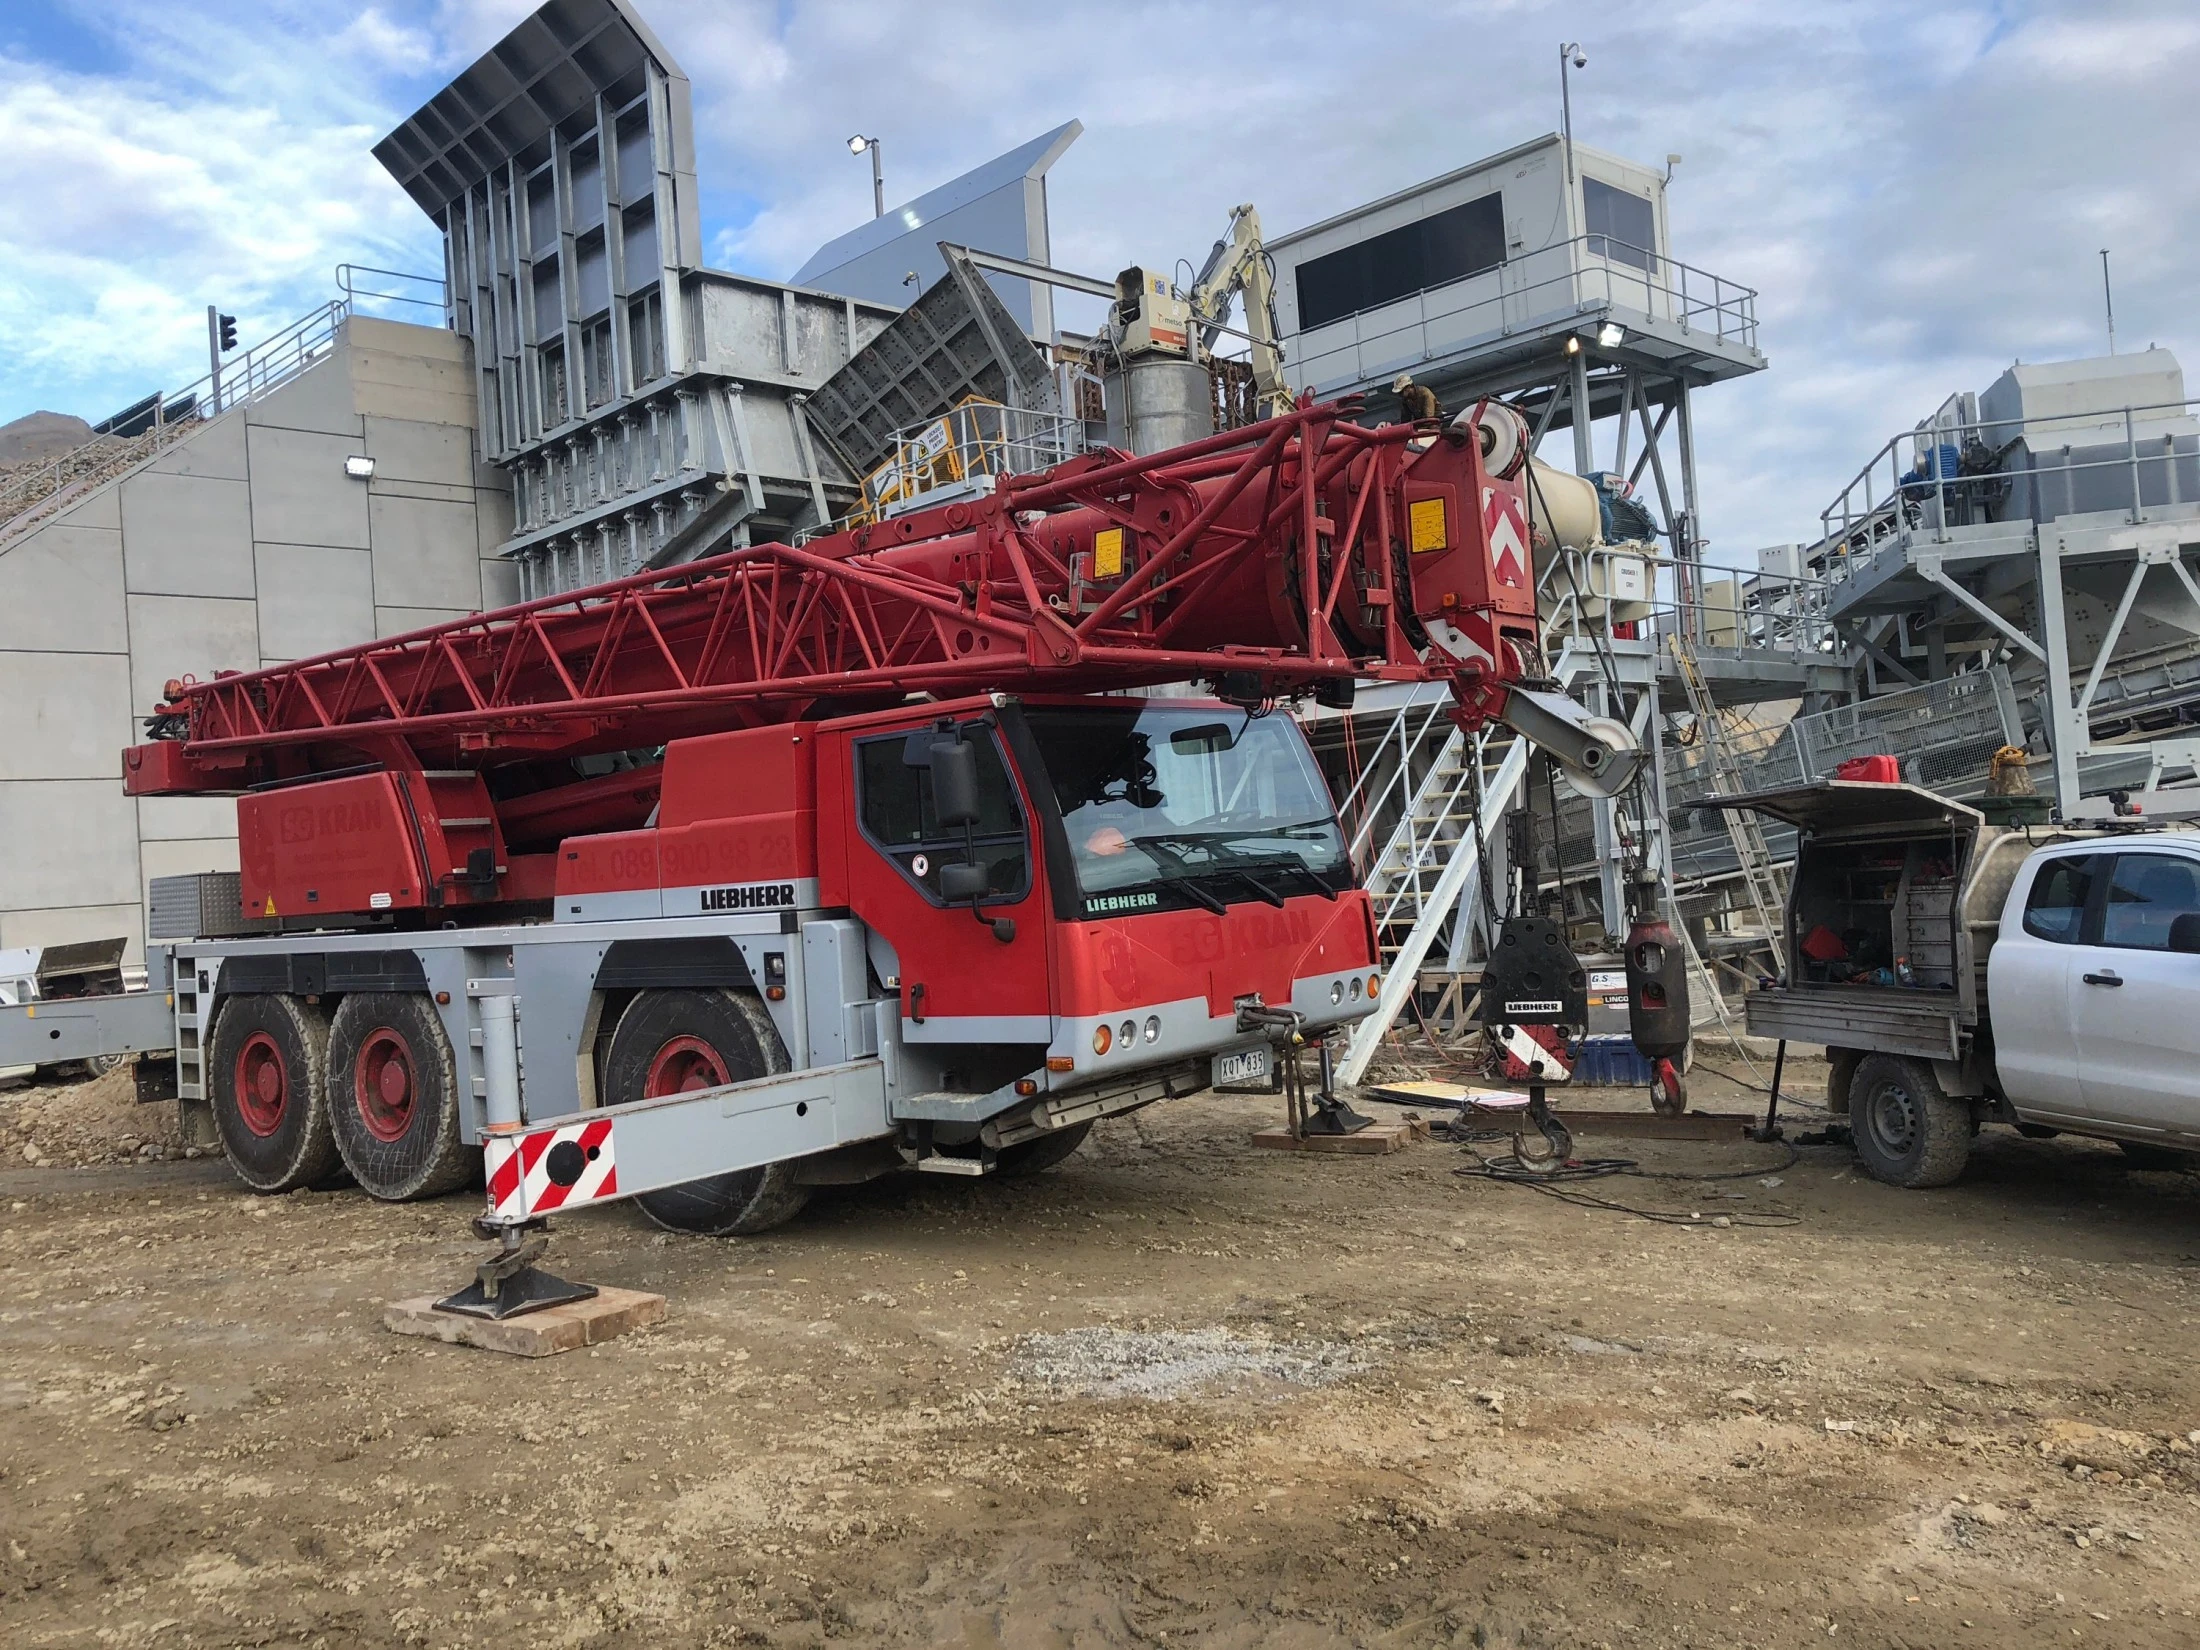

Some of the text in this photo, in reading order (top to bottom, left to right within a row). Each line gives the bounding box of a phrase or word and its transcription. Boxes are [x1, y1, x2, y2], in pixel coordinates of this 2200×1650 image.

[1165, 317, 1182, 327] metso
[926, 424, 942, 439] LOCKOUT
[928, 433, 940, 445] PRIOR
[932, 438, 944, 450] ENTRY
[700, 883, 795, 911] LIEBHERR
[1086, 892, 1159, 912] LIEBHERR
[1508, 1003, 1559, 1011] LIEBHERR
[1223, 1053, 1263, 1077] XQT 835
